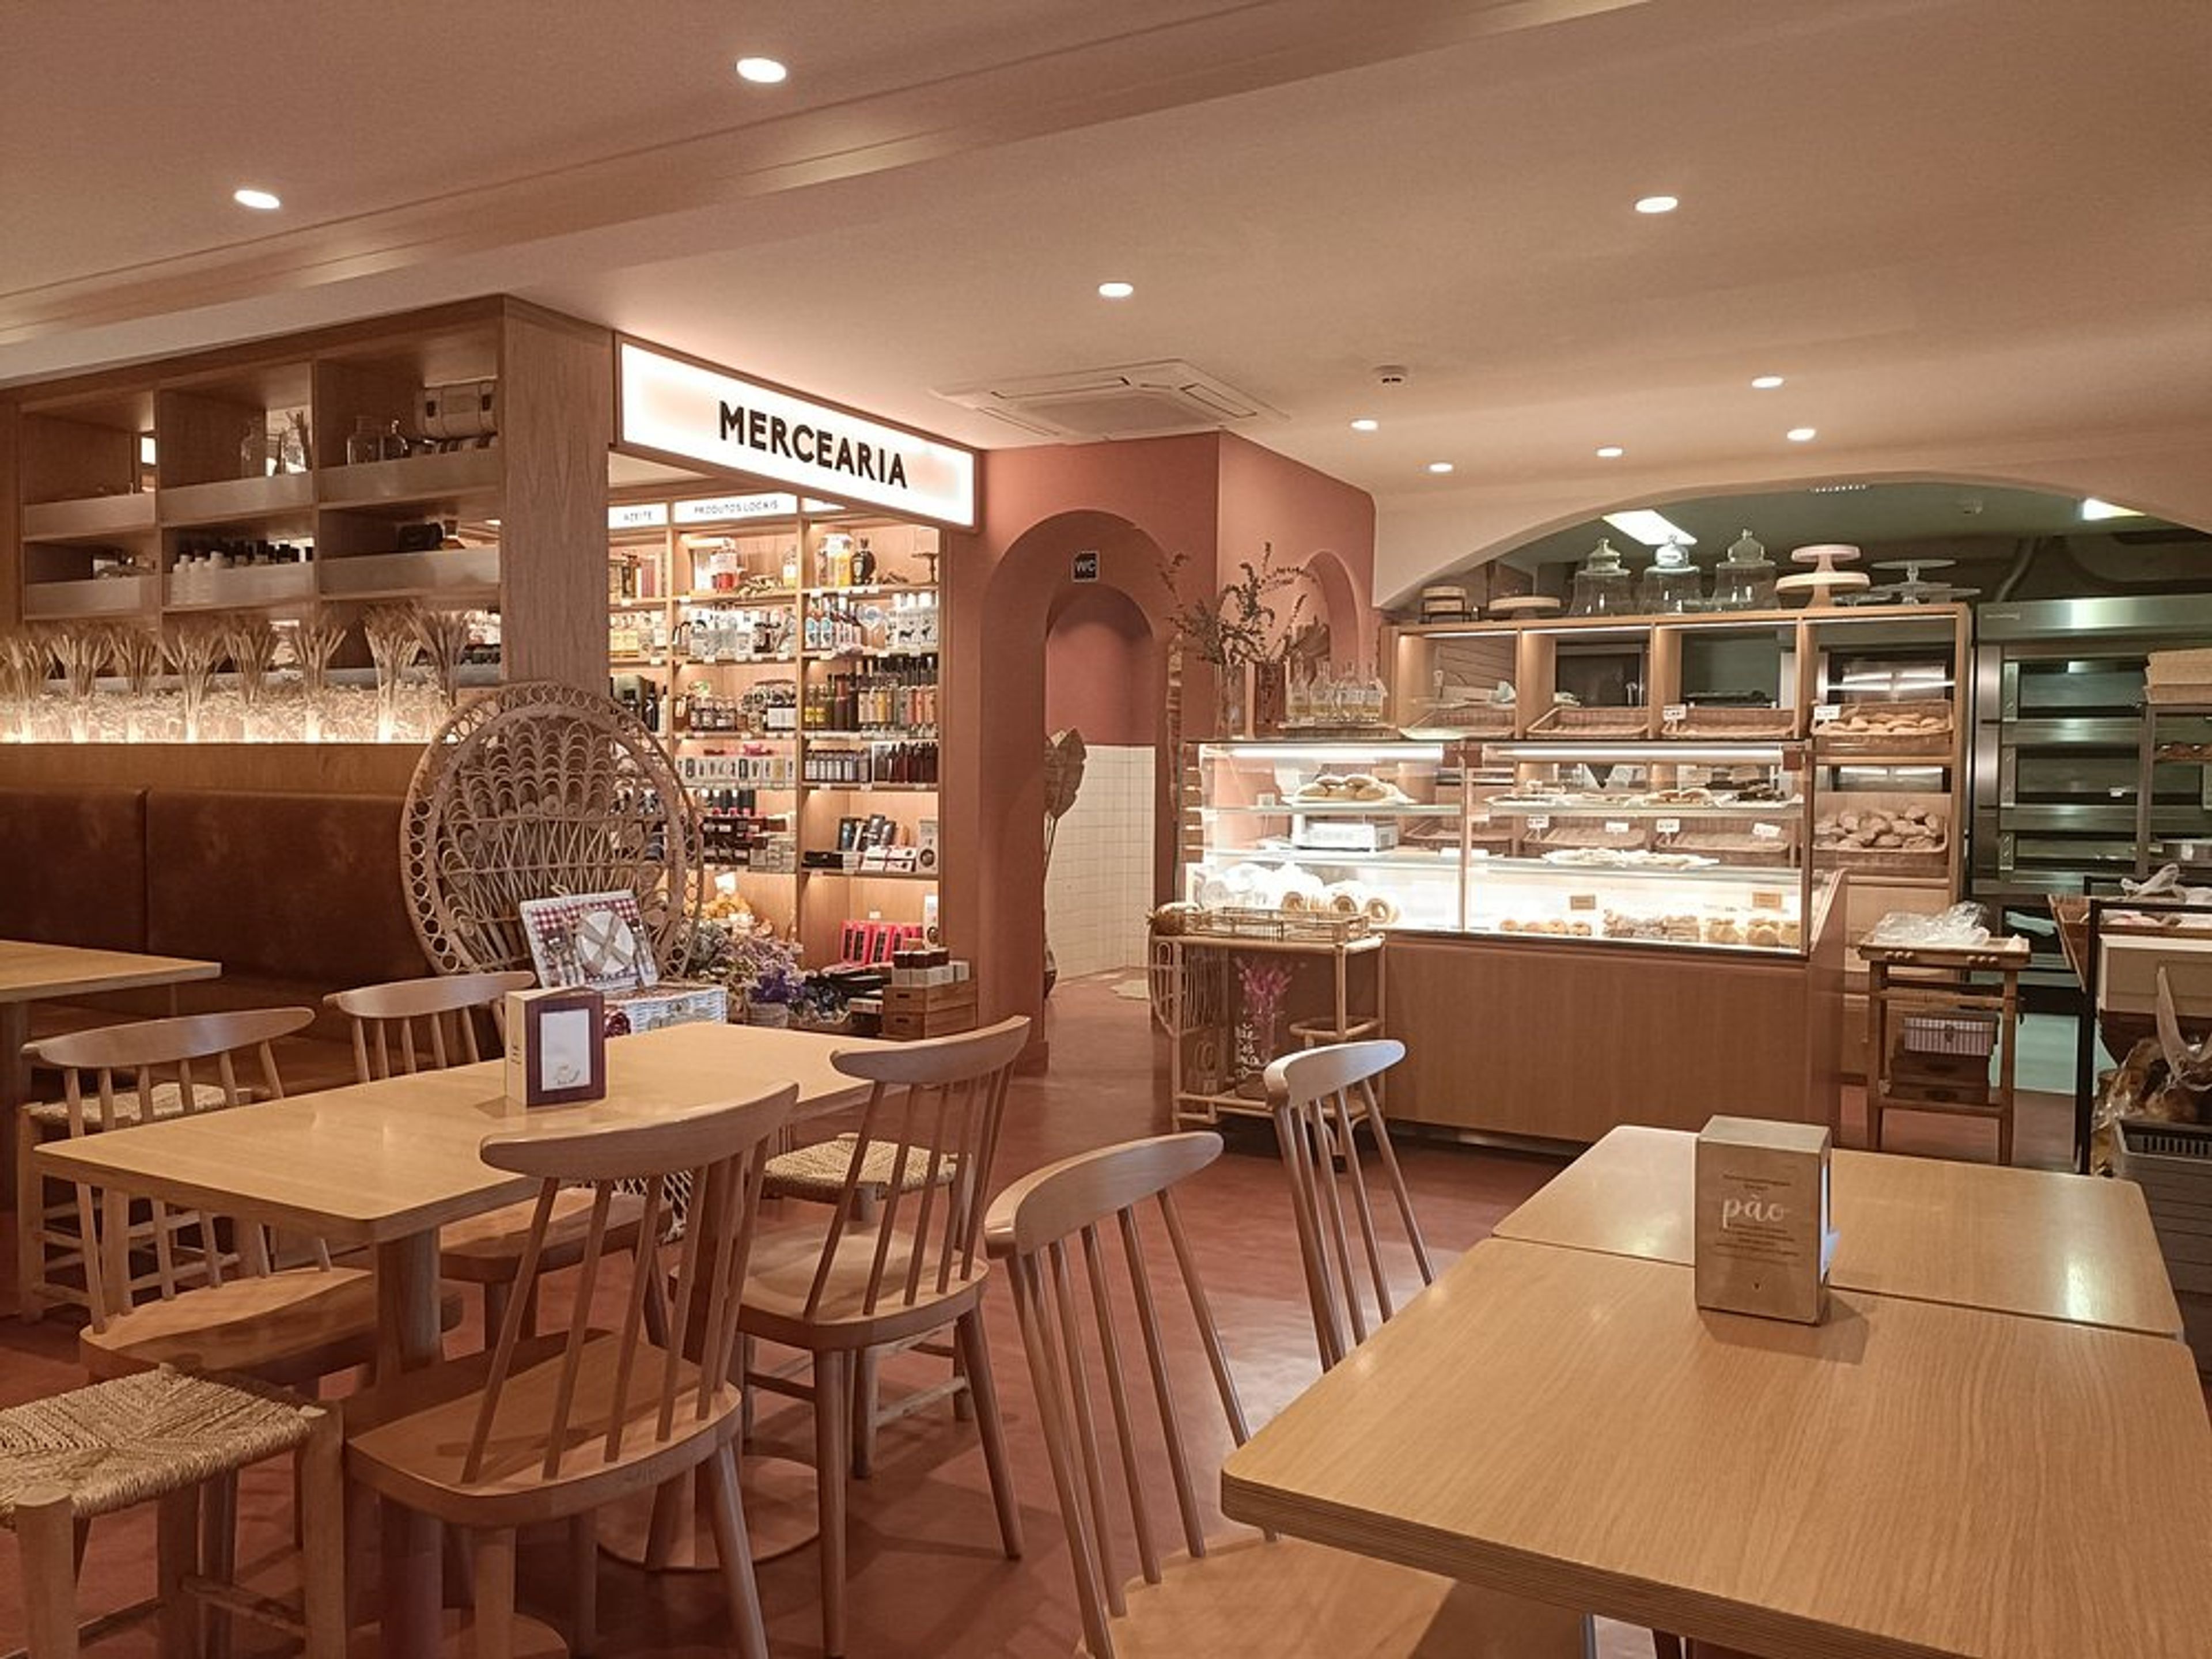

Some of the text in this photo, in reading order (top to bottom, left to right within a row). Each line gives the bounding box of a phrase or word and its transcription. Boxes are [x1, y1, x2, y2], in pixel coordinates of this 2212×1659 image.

[719, 400, 907, 489] MERCEARIA
[694, 499, 778, 514] PRODUTOS LOCAIS
[1722, 1194, 1786, 1229] pão
